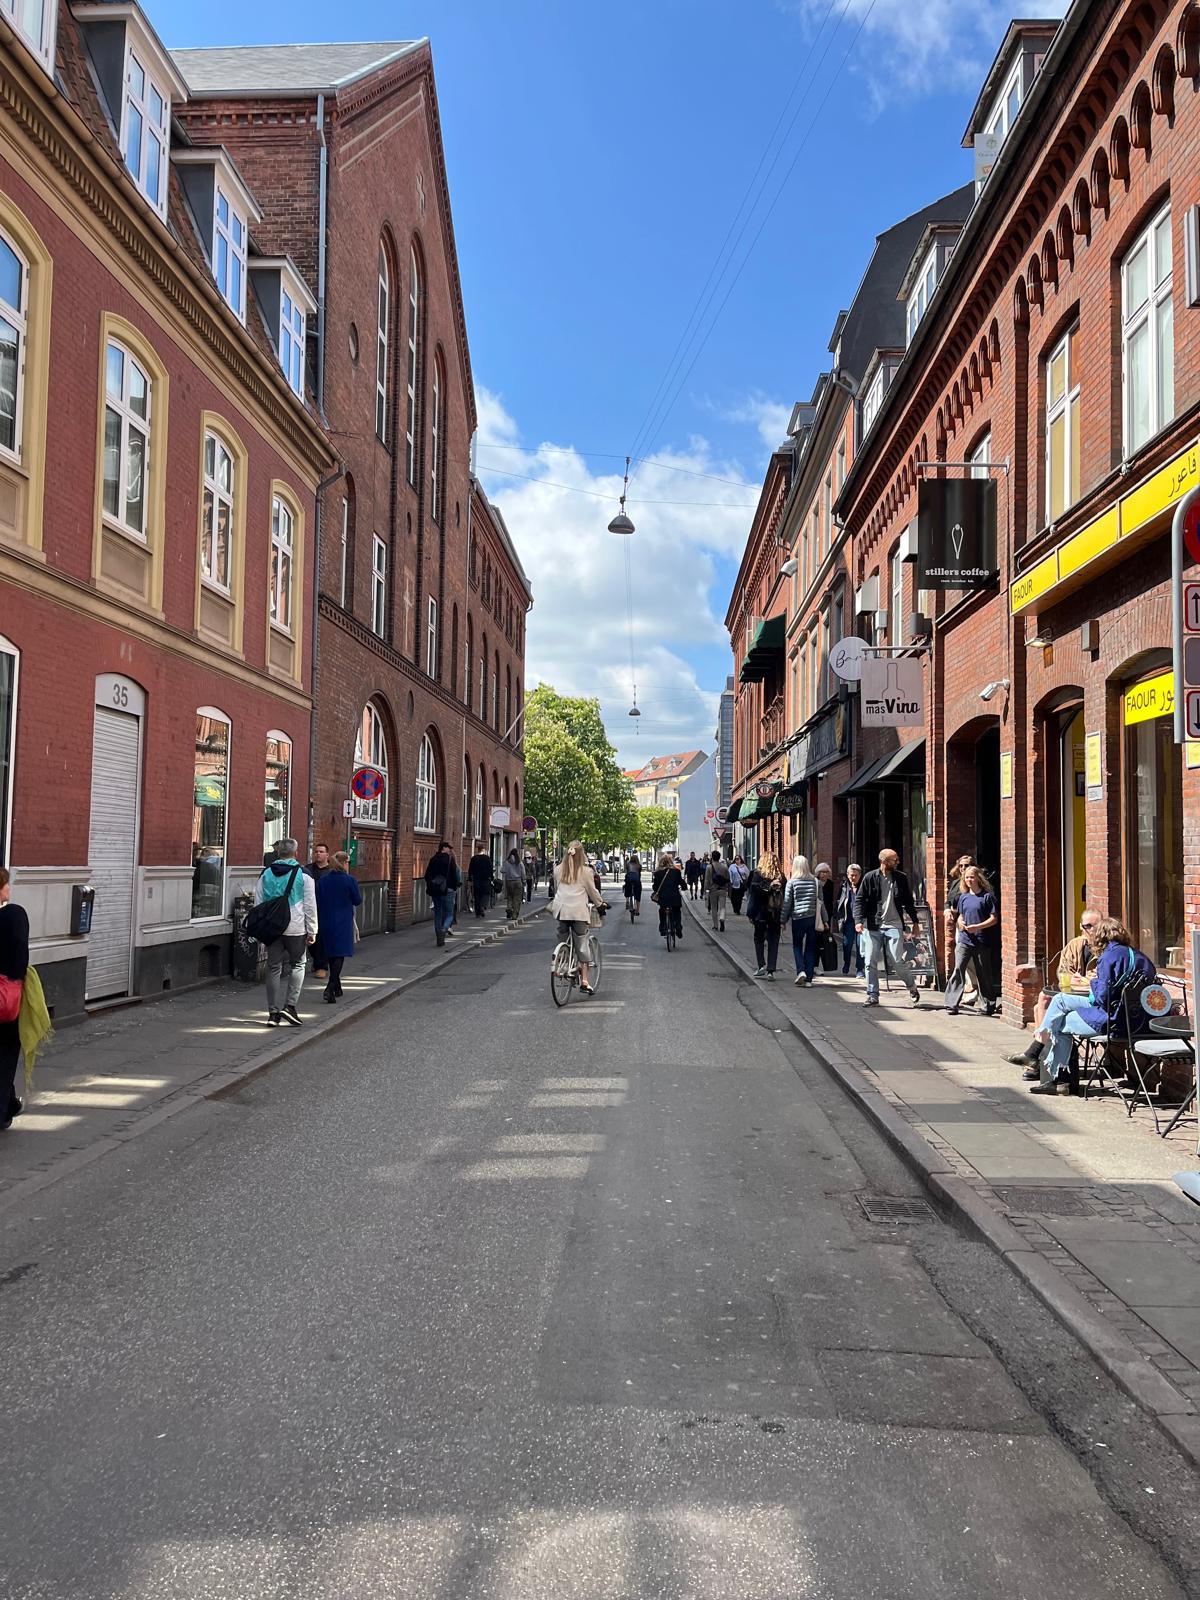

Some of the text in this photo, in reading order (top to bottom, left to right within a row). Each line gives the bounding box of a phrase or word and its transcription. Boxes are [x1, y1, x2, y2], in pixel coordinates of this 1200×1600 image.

[925, 567, 990, 576] stillers coffee
[1013, 578, 1033, 604] FAOUR
[112, 683, 128, 707] 35
[1126, 688, 1157, 712] FAOUR
